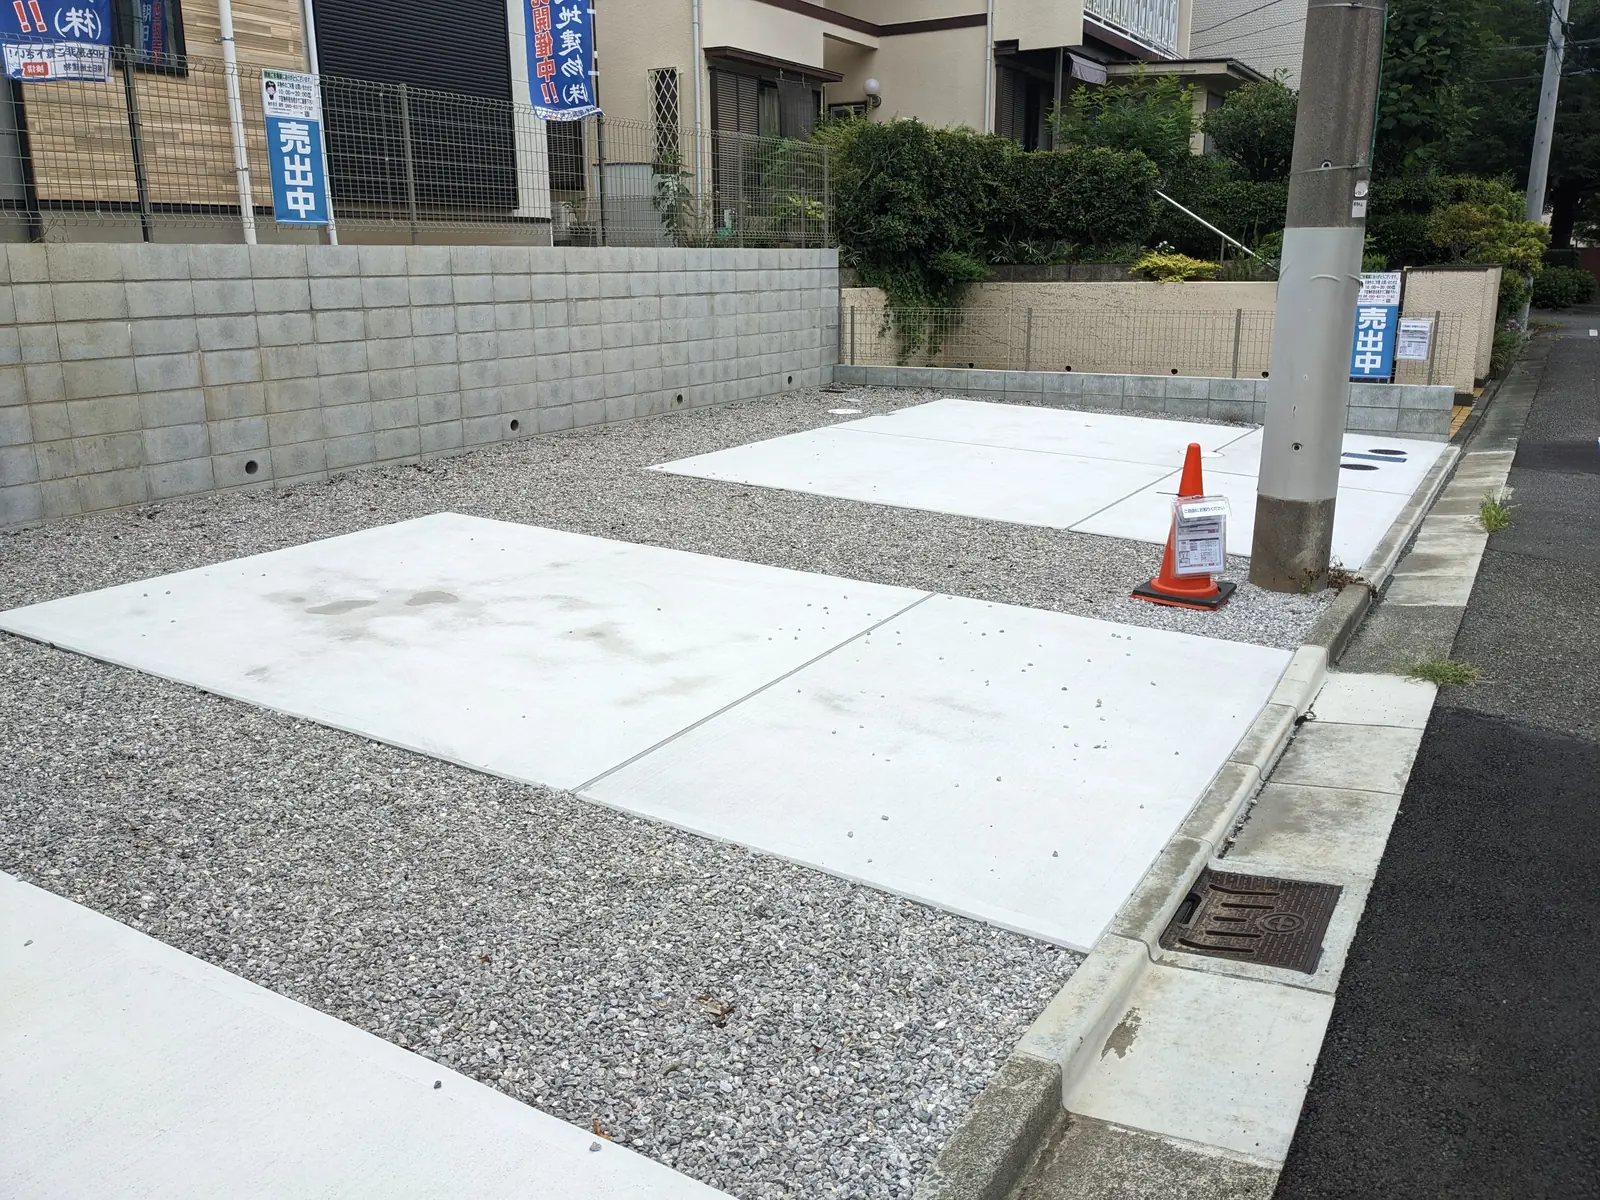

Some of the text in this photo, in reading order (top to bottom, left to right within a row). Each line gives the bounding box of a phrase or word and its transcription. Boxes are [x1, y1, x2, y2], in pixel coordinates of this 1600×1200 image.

[278, 121, 316, 219] 売出中
[1355, 307, 1388, 374] 売出中
